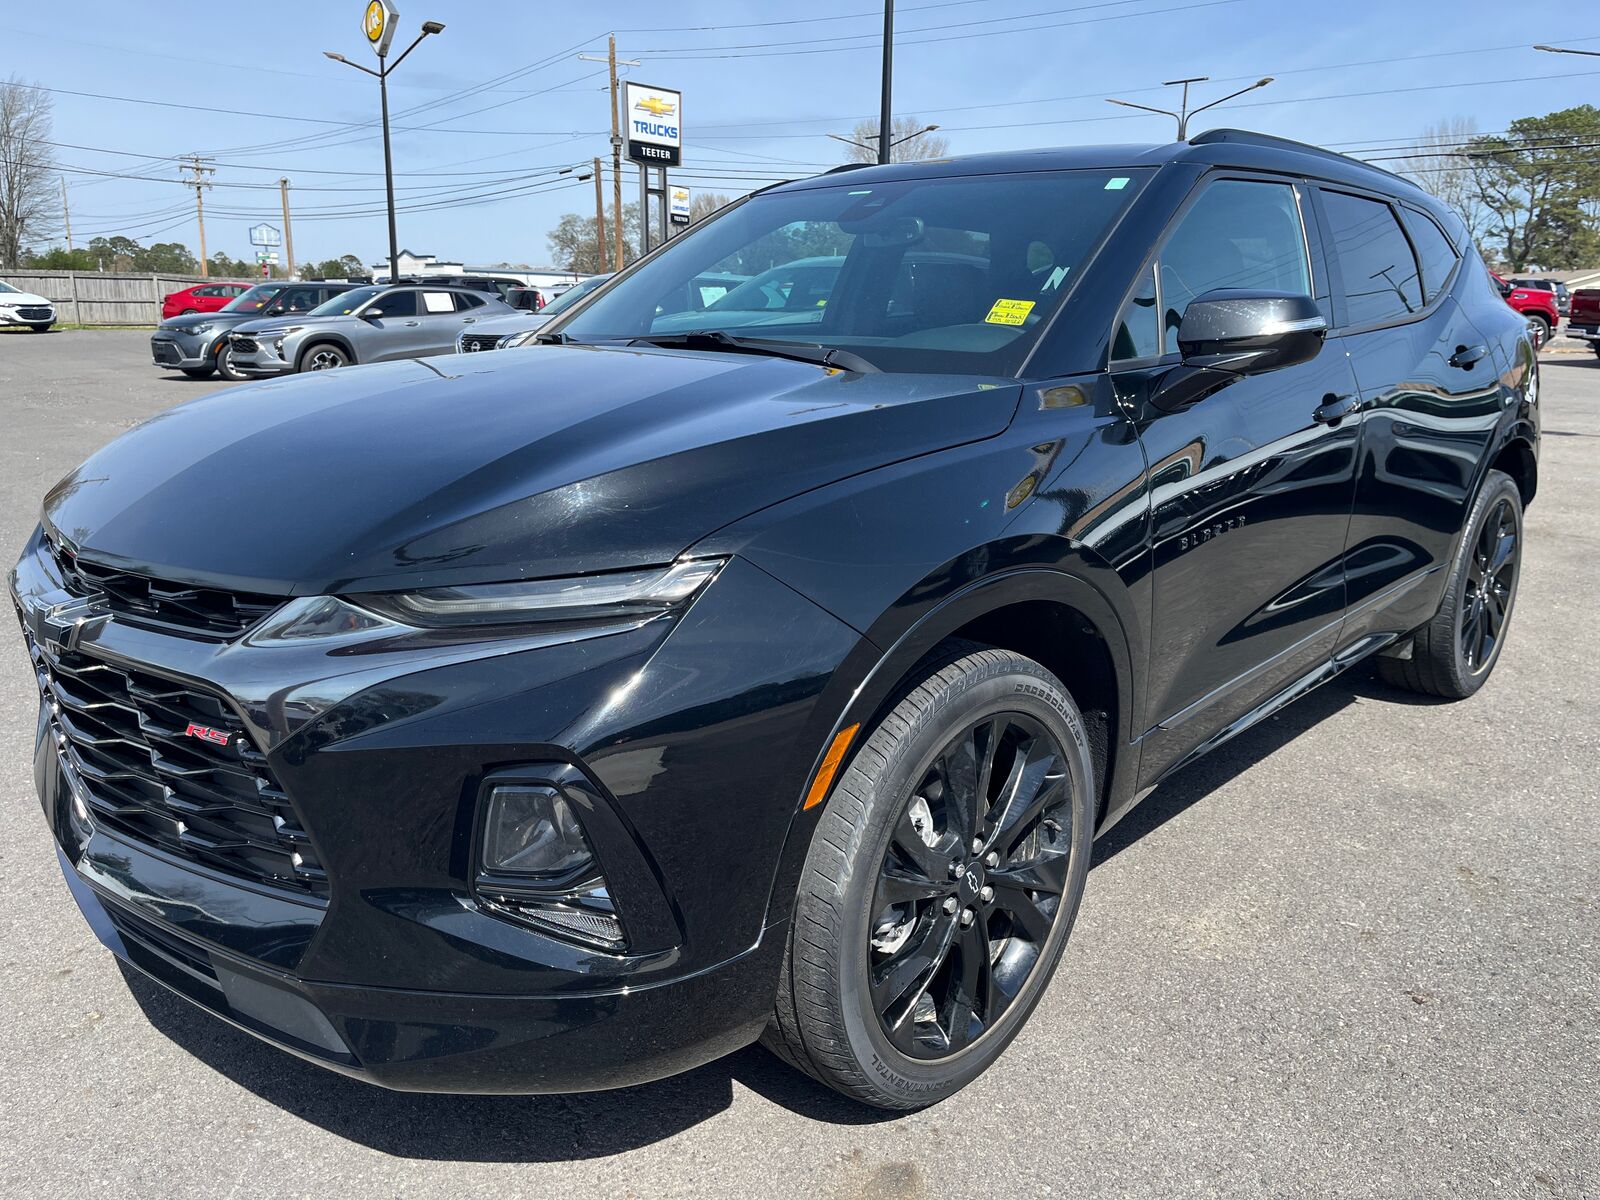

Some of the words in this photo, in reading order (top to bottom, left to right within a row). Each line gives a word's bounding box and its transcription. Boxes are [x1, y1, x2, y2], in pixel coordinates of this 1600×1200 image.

[633, 120, 678, 139] TRUCKS
[641, 147, 671, 160] TEETER
[1179, 515, 1246, 551] BLAZER
[1014, 683, 1084, 748] CROSSCONTACT
[185, 722, 229, 746] RS
